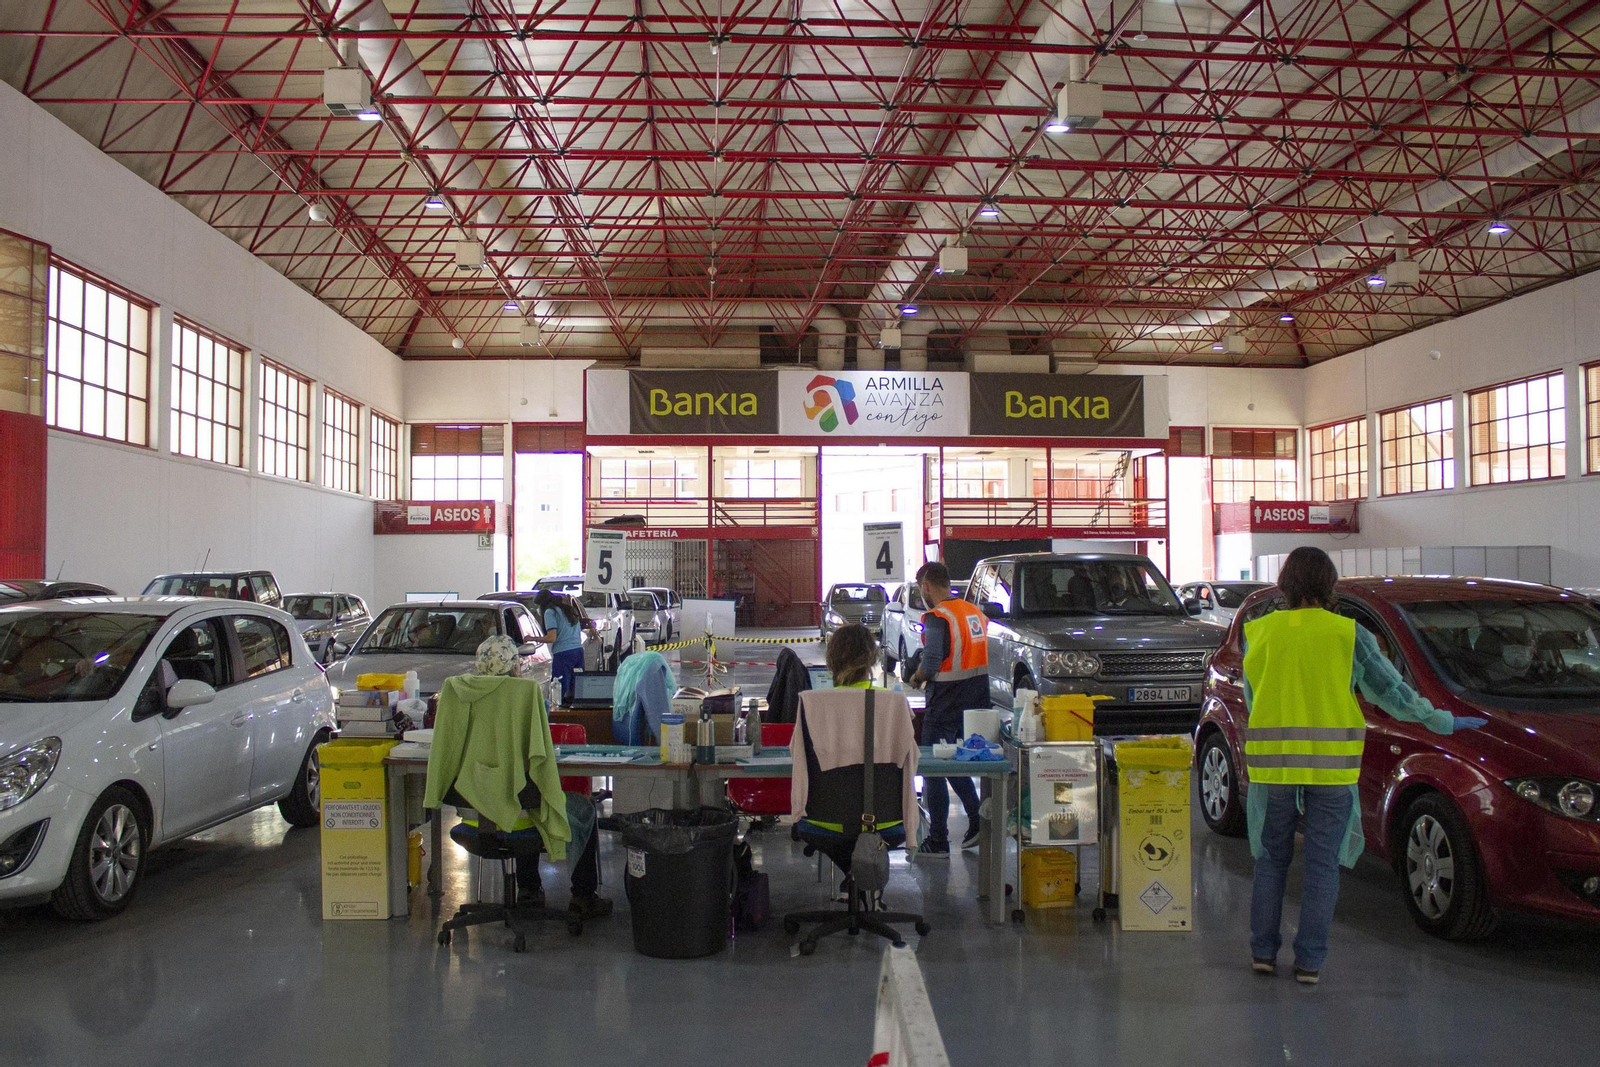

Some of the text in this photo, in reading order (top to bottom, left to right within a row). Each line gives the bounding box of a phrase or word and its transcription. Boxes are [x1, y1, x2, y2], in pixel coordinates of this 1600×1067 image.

[865, 377, 944, 391] ARMILLA
[650, 388, 758, 416] Bankia
[865, 392, 944, 407] AVANZA
[1005, 390, 1110, 419] Bankia
[866, 402, 943, 433] contigo
[434, 508, 480, 522] ASEOS
[1263, 508, 1306, 521] ASEOS
[625, 529, 679, 538] AFETERÍA
[876, 540, 893, 575] 4
[597, 550, 612, 585] 5
[1136, 690, 1187, 700] 2894 LNR
